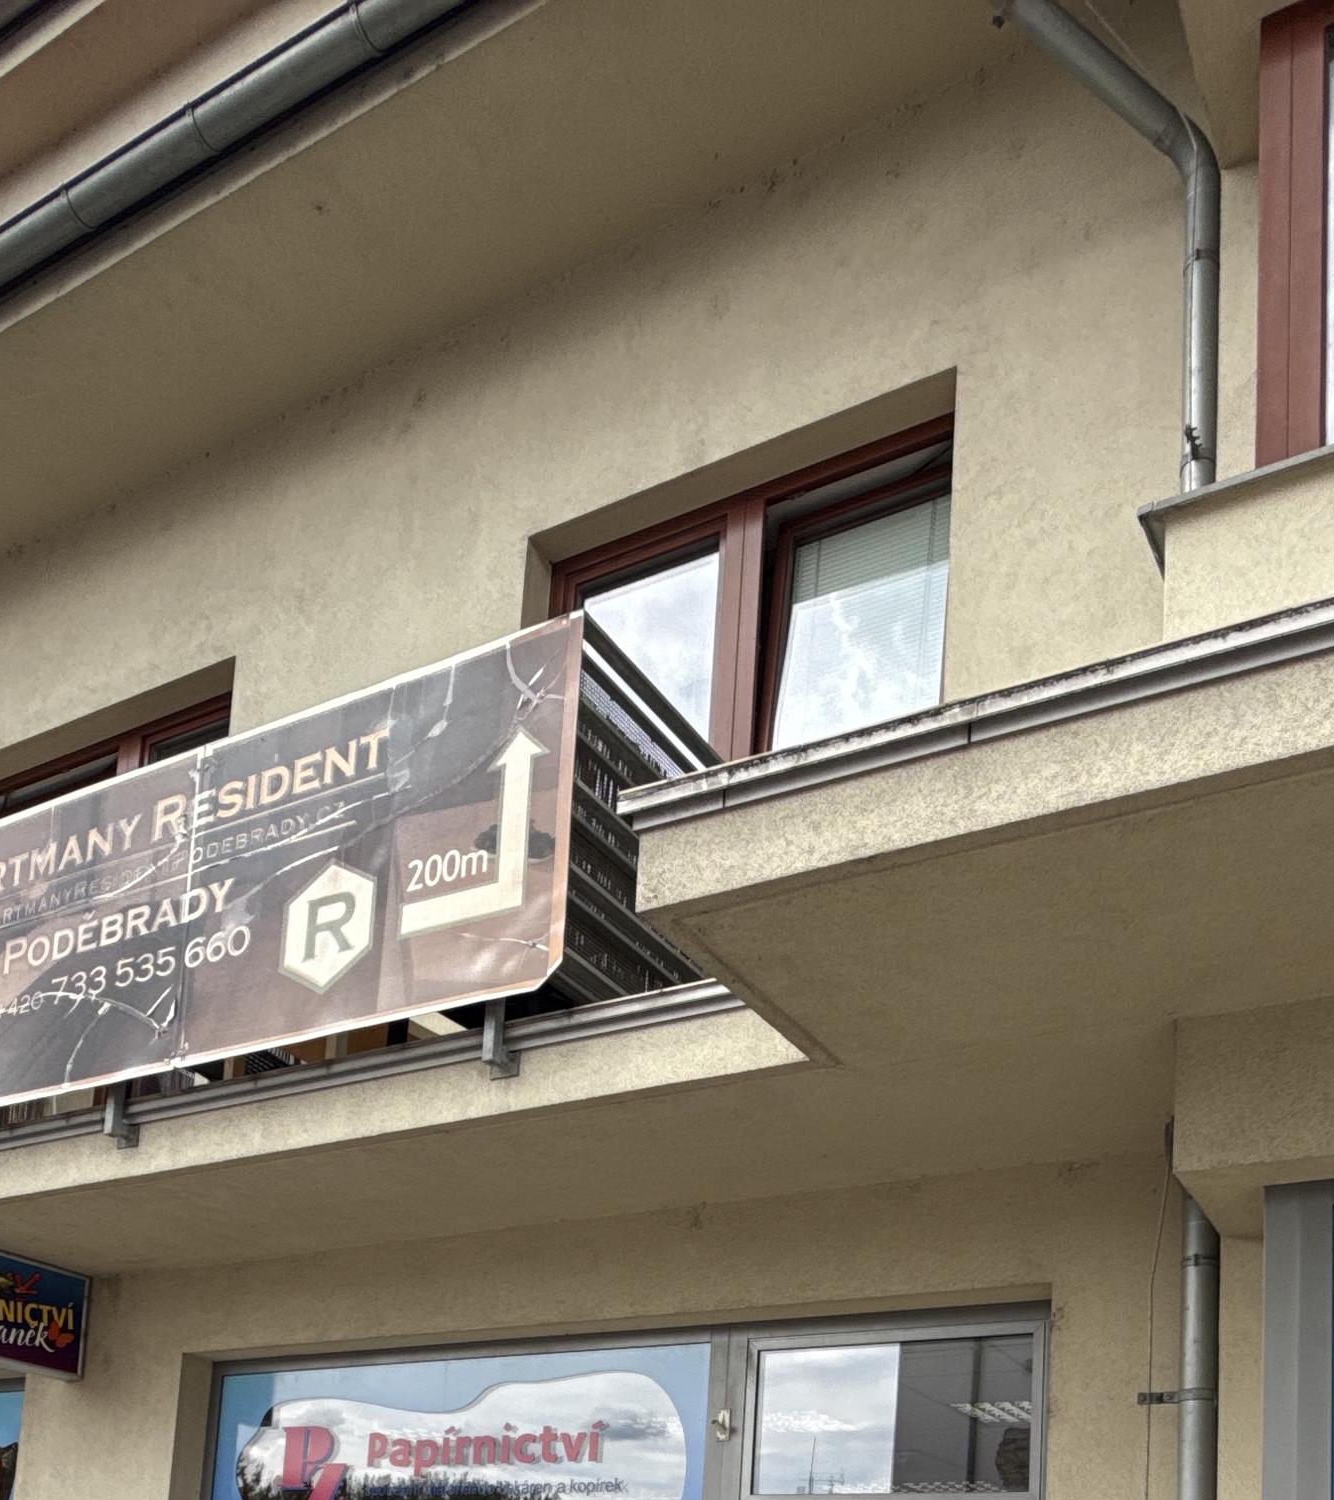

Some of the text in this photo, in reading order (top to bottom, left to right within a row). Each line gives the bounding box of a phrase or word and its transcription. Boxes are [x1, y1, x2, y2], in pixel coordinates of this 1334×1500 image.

[151, 728, 391, 843] RESIDENT
[406, 849, 490, 893] 200m
[3, 877, 235, 976] PODĚBRADY
[302, 890, 356, 963] R
[50, 965, 107, 1006] 733
[114, 946, 176, 988] 535
[184, 925, 252, 969] 660
[367, 1420, 608, 1477] Papírnictví
